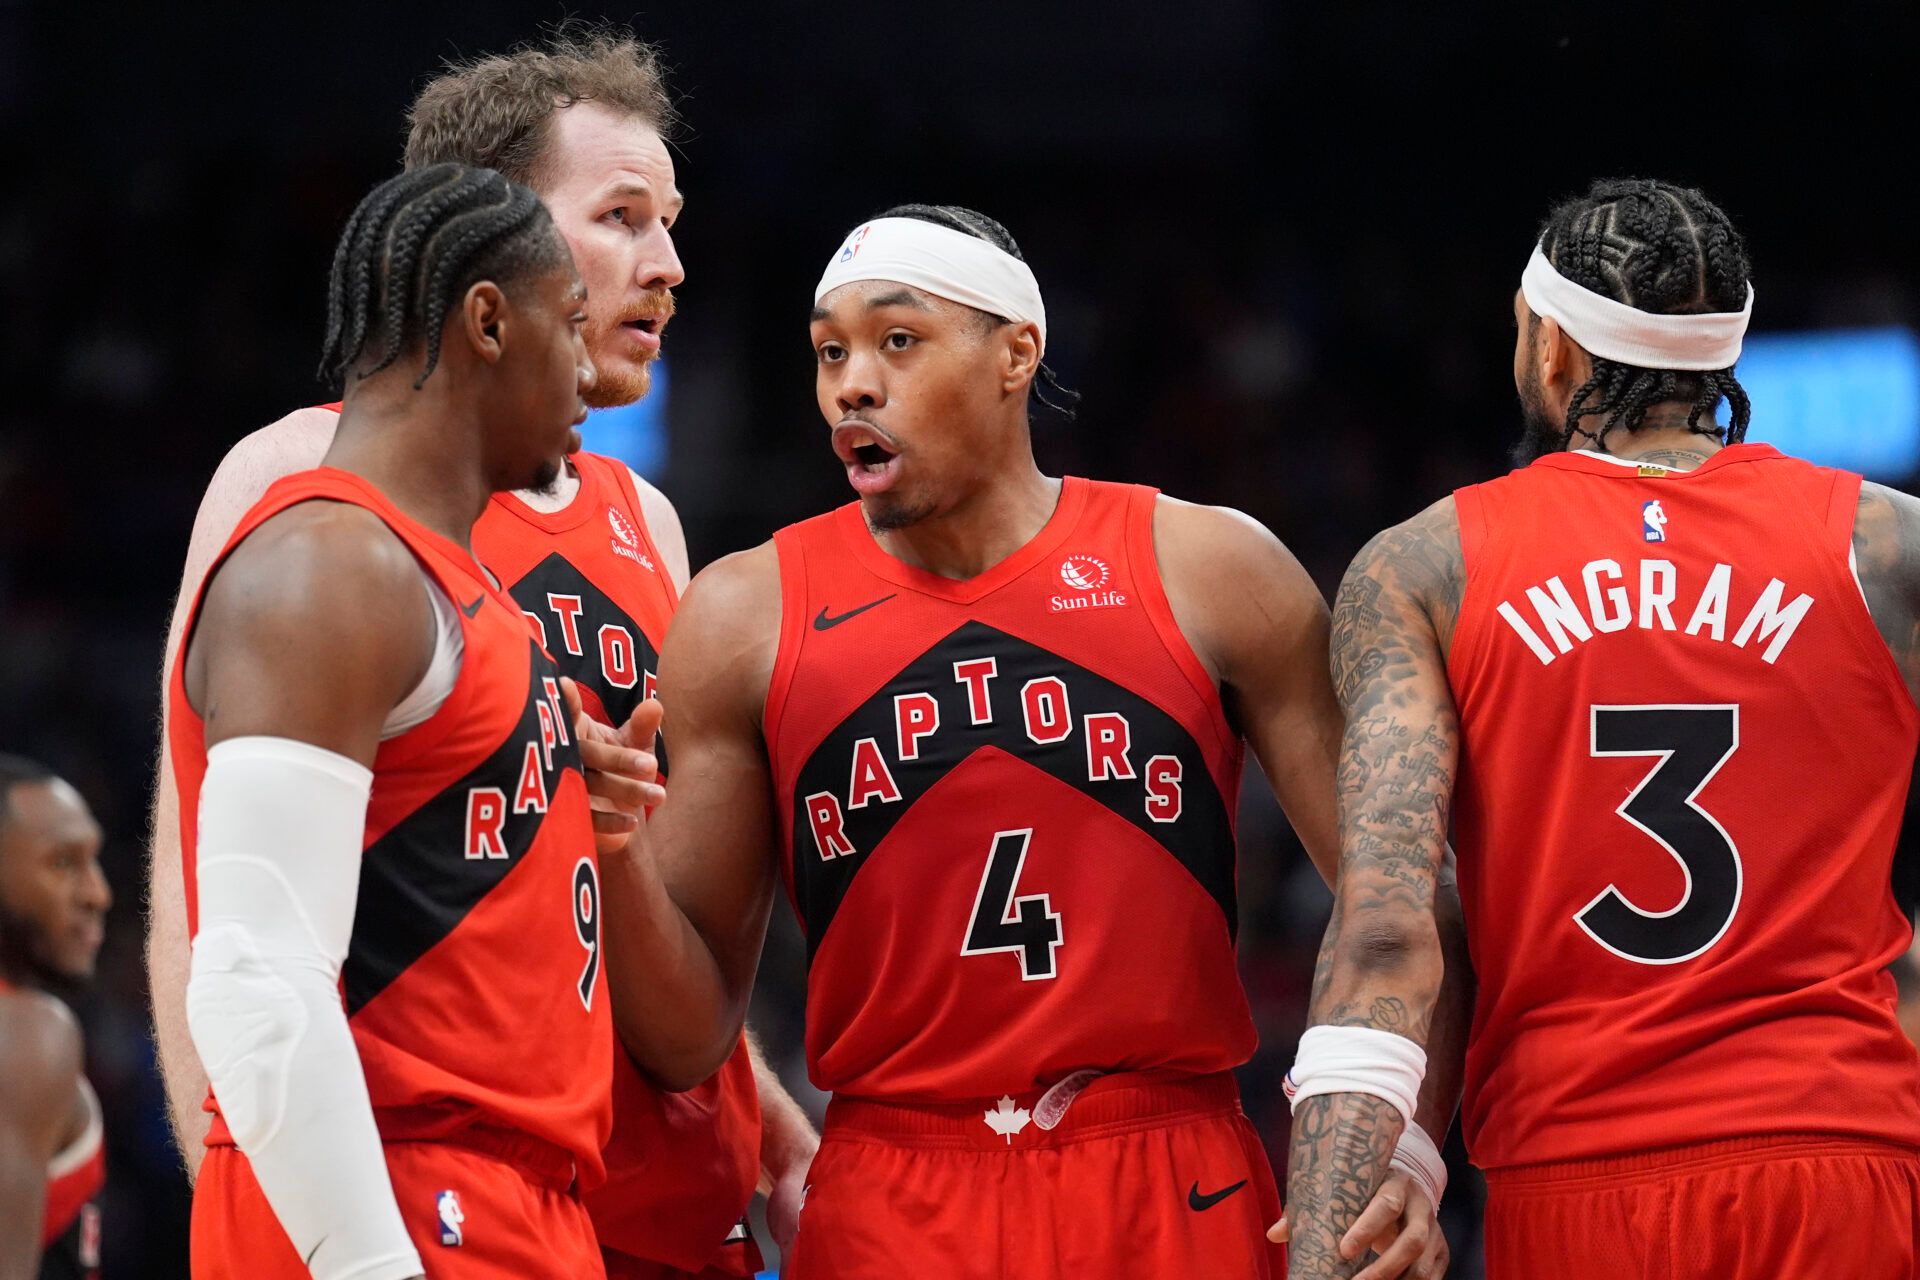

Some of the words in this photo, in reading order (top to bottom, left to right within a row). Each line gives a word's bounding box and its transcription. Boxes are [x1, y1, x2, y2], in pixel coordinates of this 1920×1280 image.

[1051, 596, 1088, 611] Sun
[1090, 591, 1127, 606] Life
[1496, 559, 1815, 666] INGRAM
[805, 656, 1182, 861] RAPTORS
[1364, 716, 1408, 739] The
[1373, 744, 1396, 778] of
[1358, 834, 1384, 853] the
[1572, 703, 1744, 966] 3
[572, 856, 600, 1013] 9
[960, 827, 1064, 982] 4
